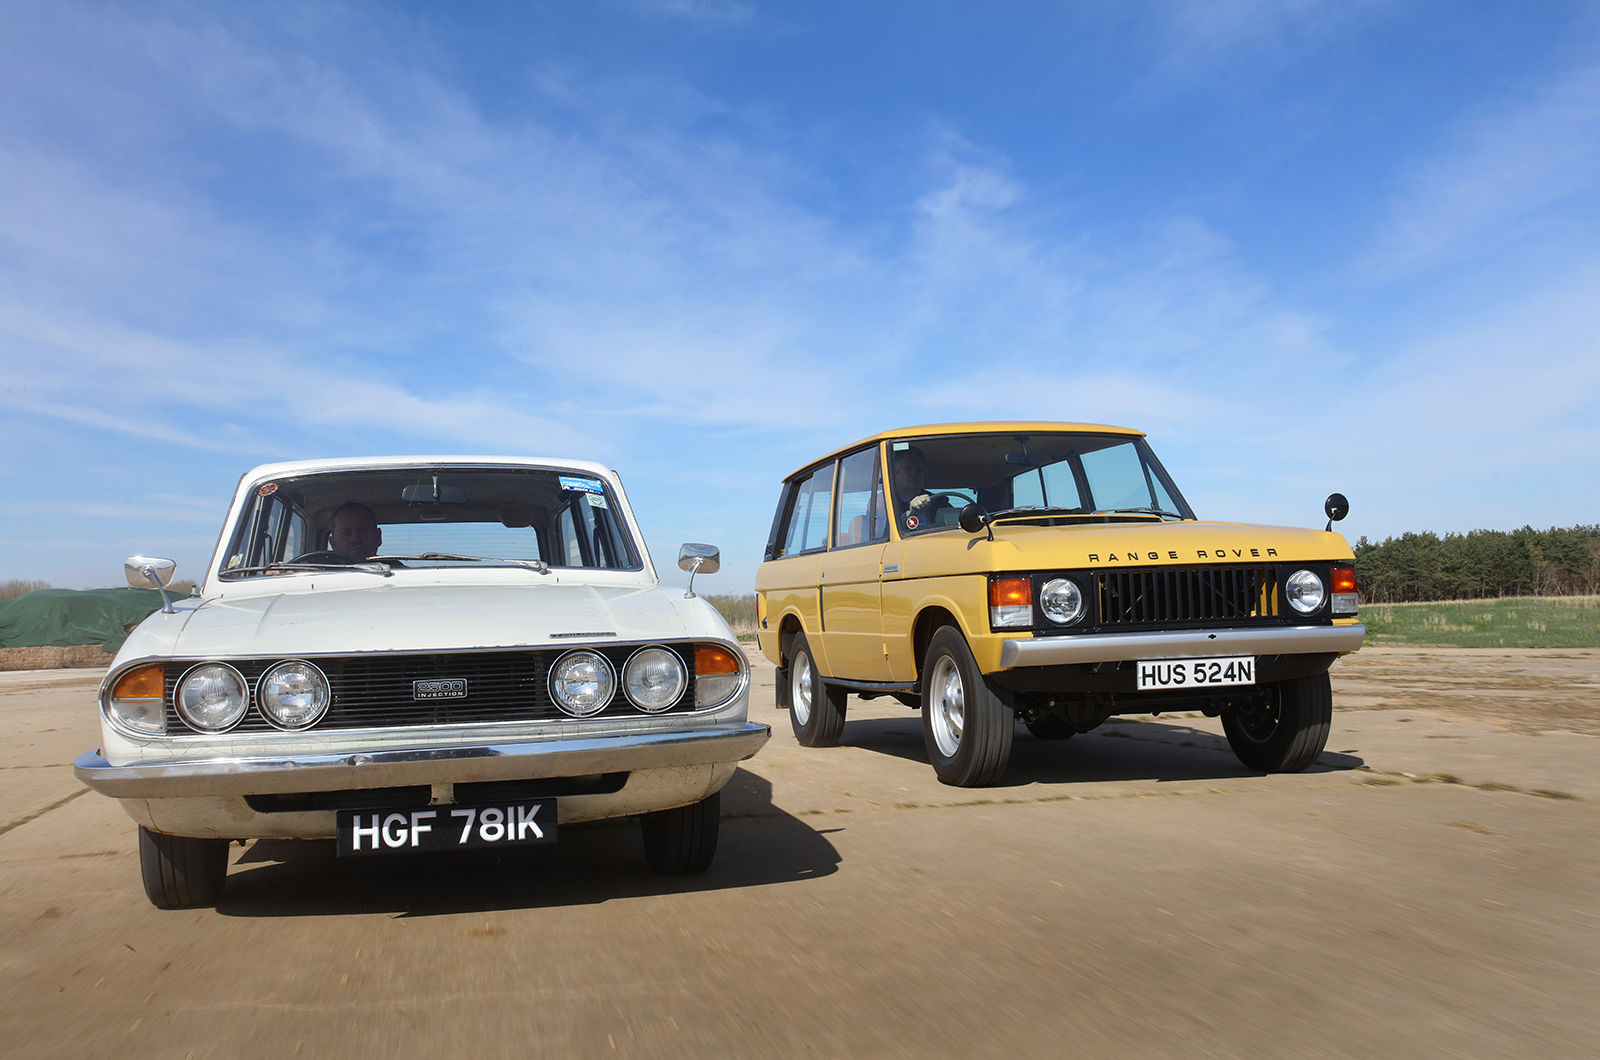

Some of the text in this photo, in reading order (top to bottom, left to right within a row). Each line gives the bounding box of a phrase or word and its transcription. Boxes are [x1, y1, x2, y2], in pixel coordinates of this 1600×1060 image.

[1088, 548, 1278, 563] RANGE ROVER
[1141, 660, 1252, 687] HUS 524N
[417, 681, 463, 693] 2500
[352, 804, 544, 851] HGF 781K
